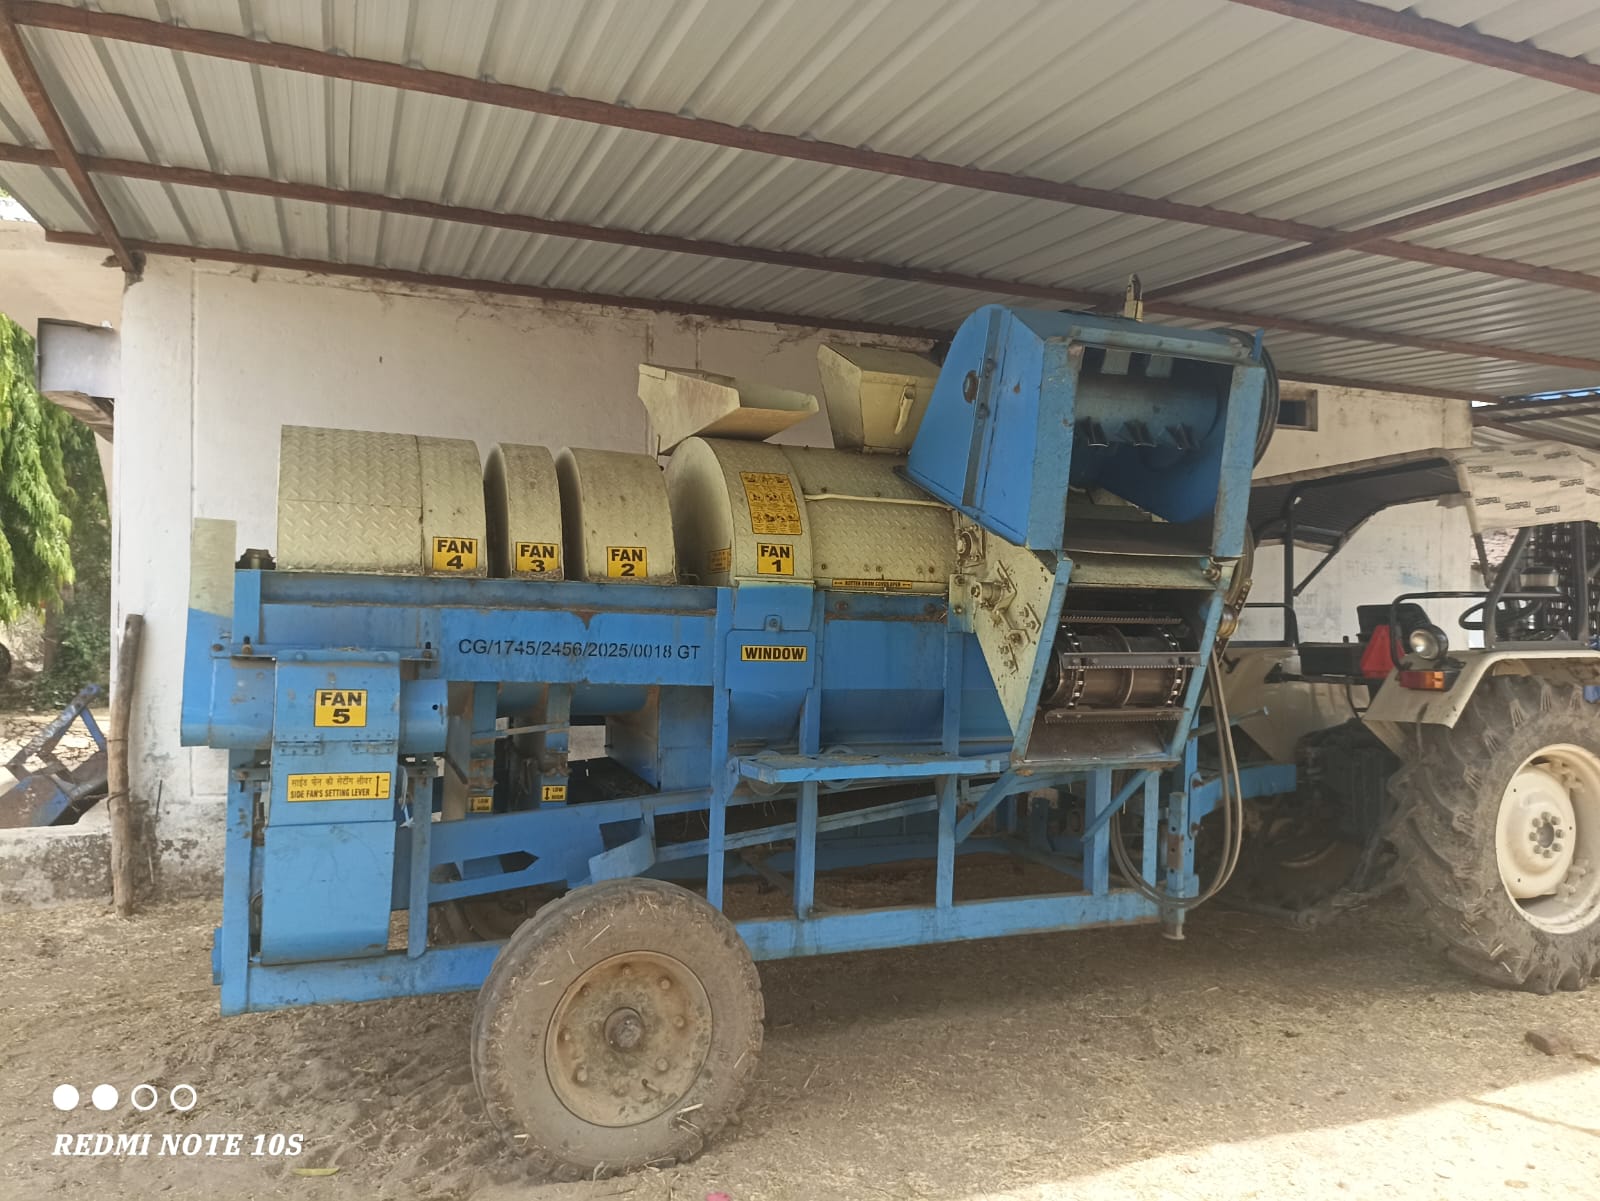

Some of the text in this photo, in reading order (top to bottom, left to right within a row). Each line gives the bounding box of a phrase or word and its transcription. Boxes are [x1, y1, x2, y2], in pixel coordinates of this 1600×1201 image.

[437, 539, 473, 554] FAN
[520, 544, 555, 559] FAN
[760, 545, 790, 558] FAN
[446, 555, 463, 569] 4
[611, 549, 643, 562] FAN
[530, 559, 546, 572] 3
[620, 563, 635, 576] 2
[771, 559, 782, 572] 1
[458, 639, 700, 659] CG/1745/2456/2025/0018 GT
[744, 647, 805, 660] WINDOW
[320, 692, 362, 706] FAN
[332, 709, 351, 724] 5
[290, 788, 370, 798] SIDE FAN'S SETTING LEVER
